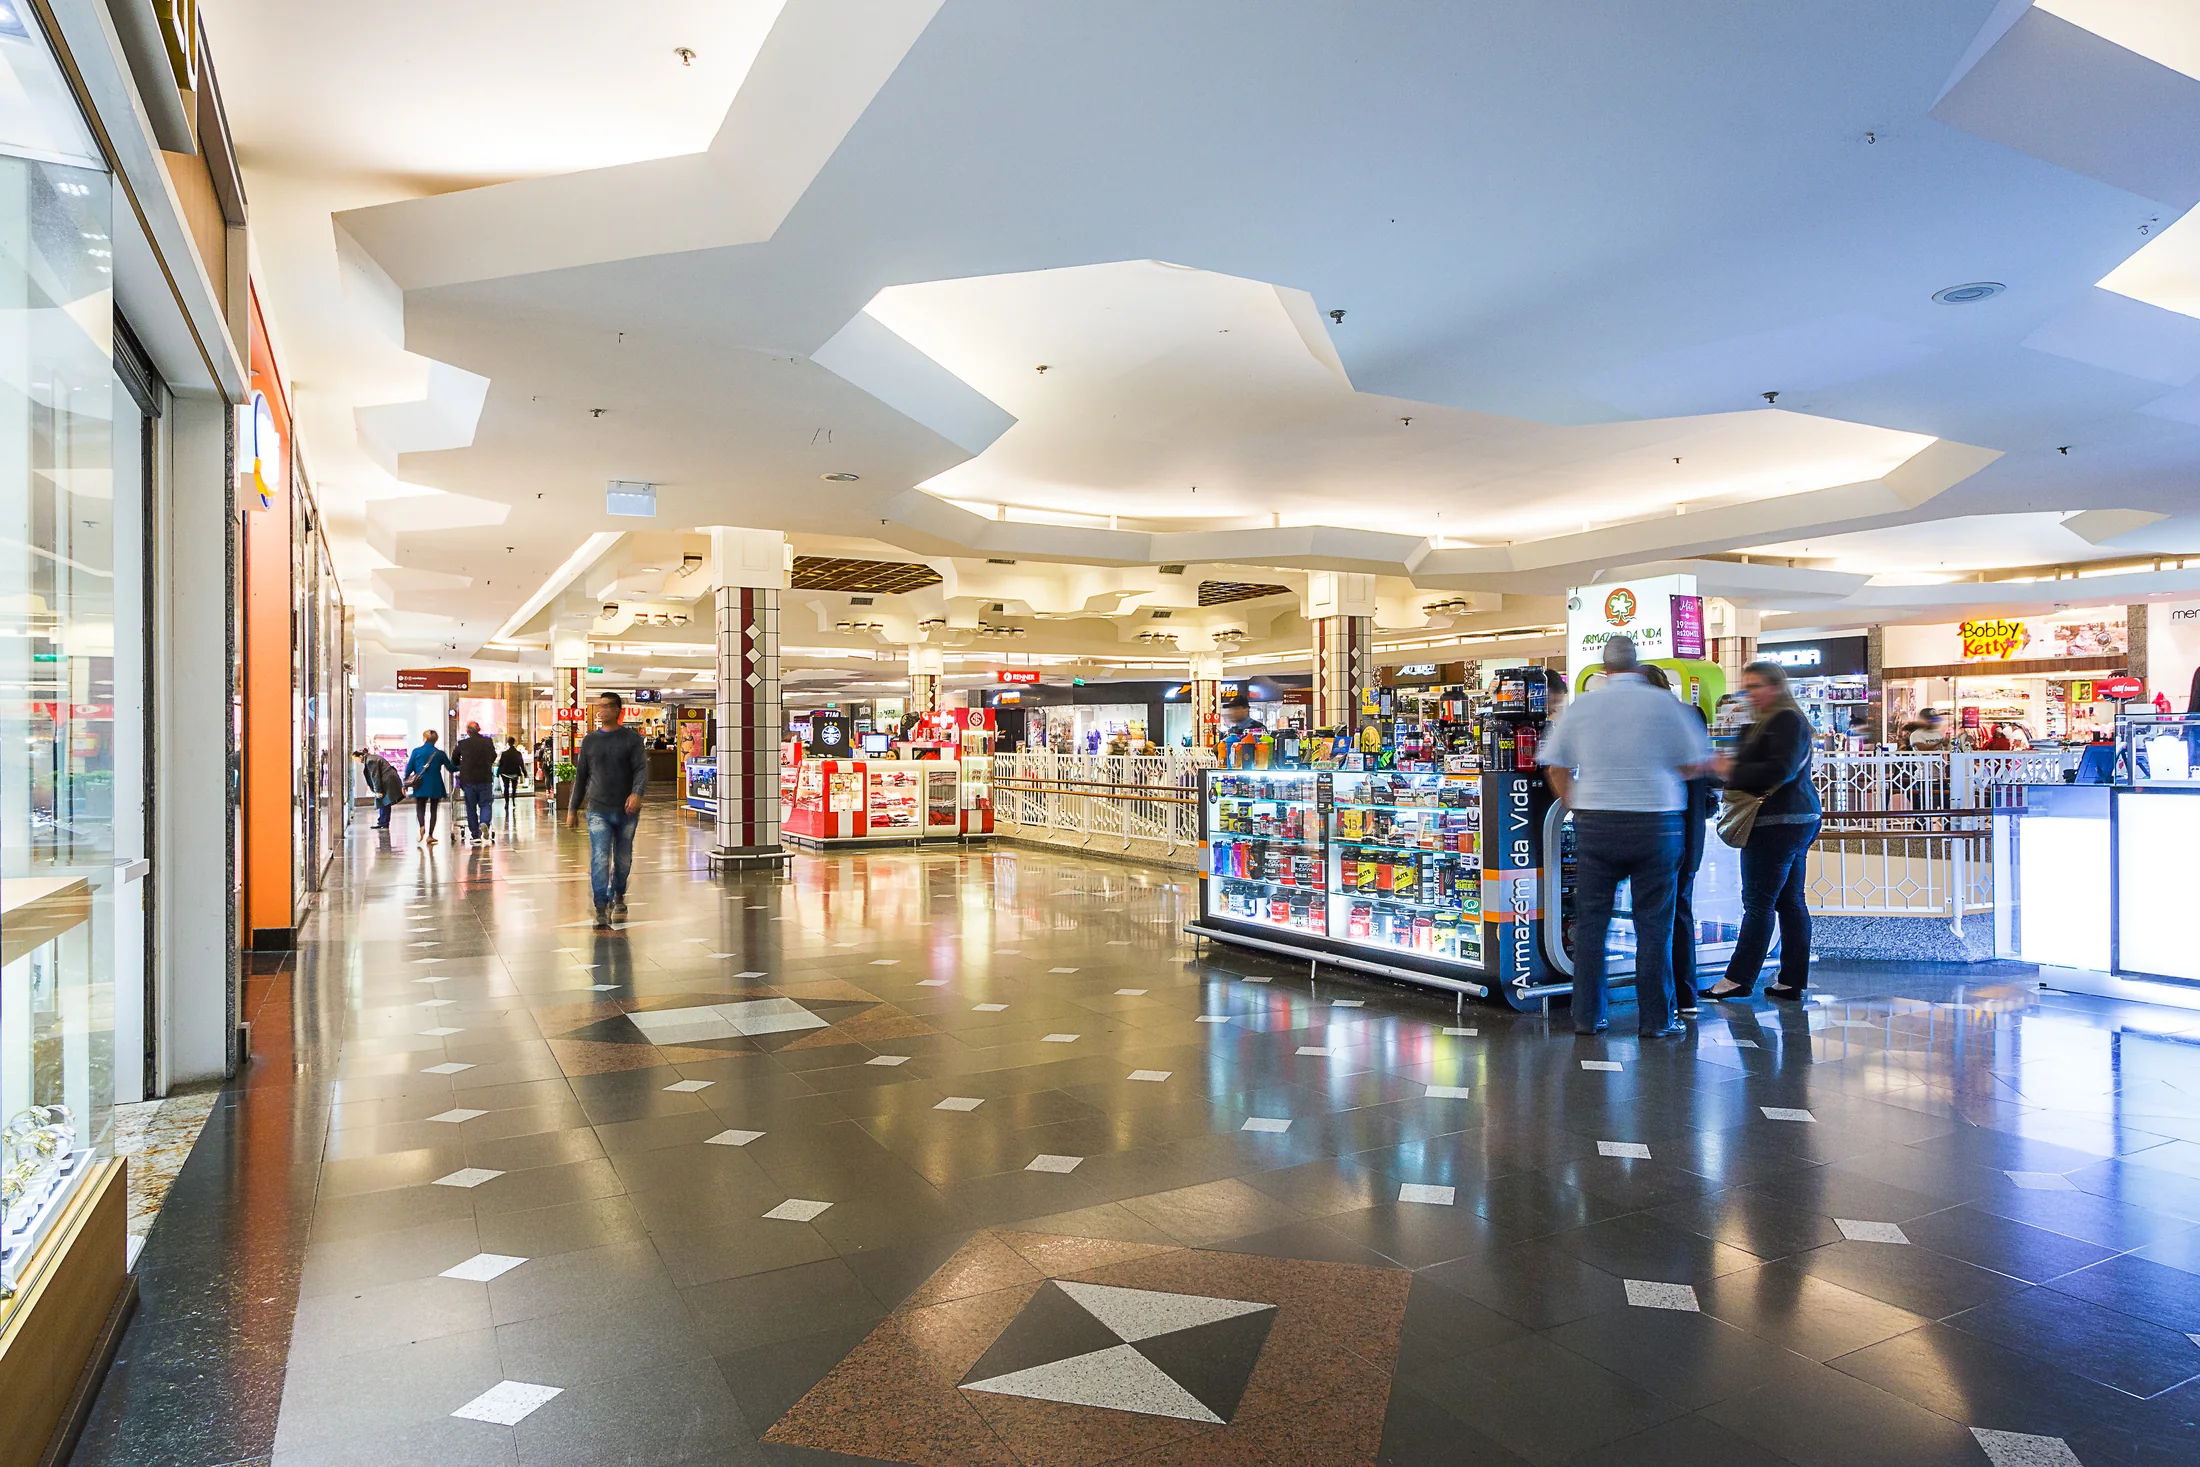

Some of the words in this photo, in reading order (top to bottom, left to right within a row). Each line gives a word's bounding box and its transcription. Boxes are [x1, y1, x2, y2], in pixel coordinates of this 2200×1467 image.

[1963, 620, 2020, 639] Bobby
[1963, 639, 2009, 659] Ketty
[1012, 673, 1035, 681] RENNER
[1509, 779, 1529, 831] Vida
[1511, 839, 1530, 867] da
[1511, 877, 1531, 989] Armazém
